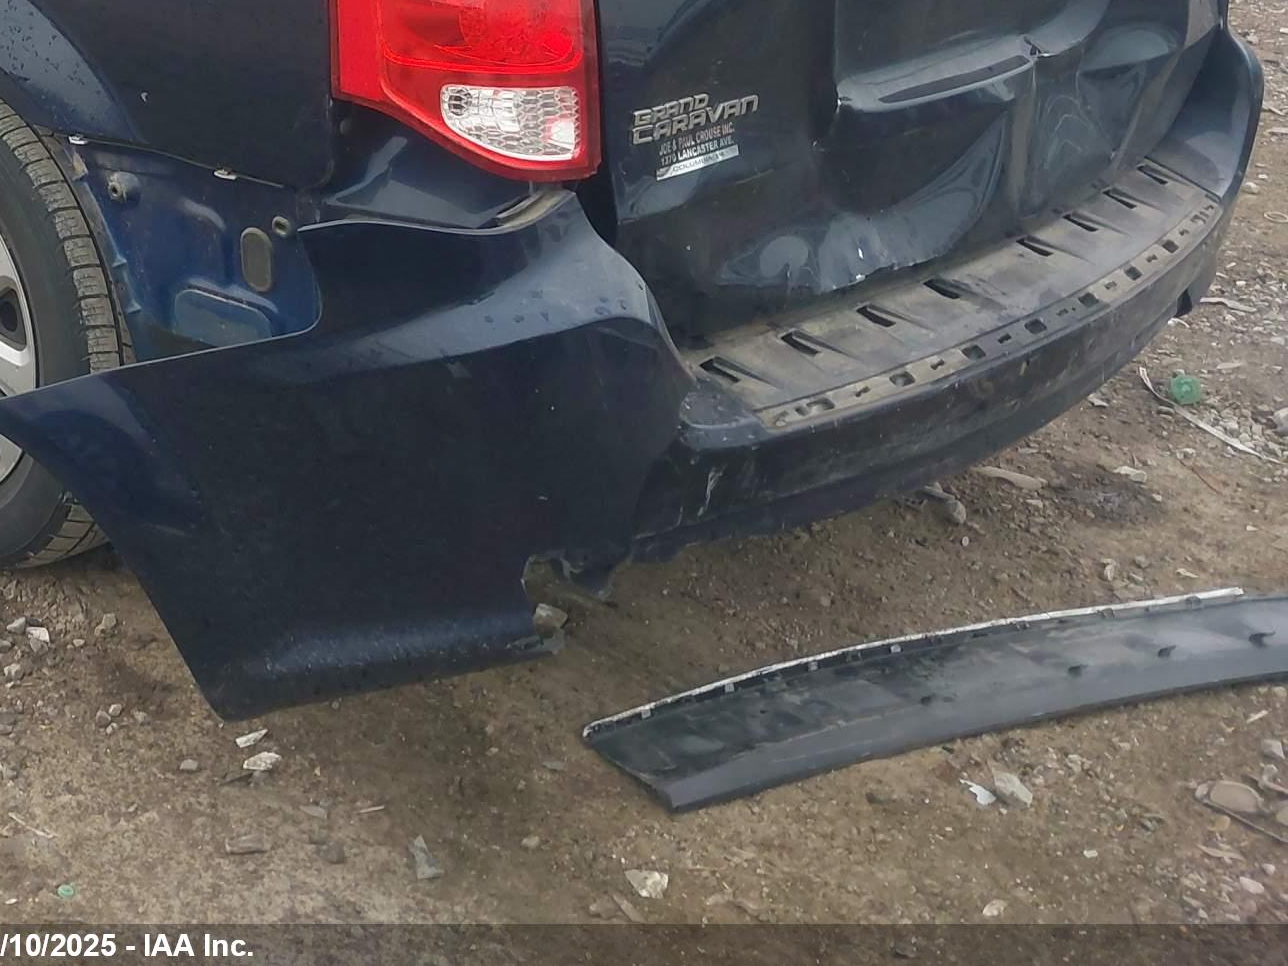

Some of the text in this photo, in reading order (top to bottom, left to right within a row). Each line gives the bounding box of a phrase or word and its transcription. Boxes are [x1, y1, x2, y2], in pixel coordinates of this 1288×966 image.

[631, 94, 760, 145] CARAVAN
[633, 93, 710, 126] GRAND
[677, 138, 719, 161] LANCASTER
[678, 133, 695, 151] PAUL
